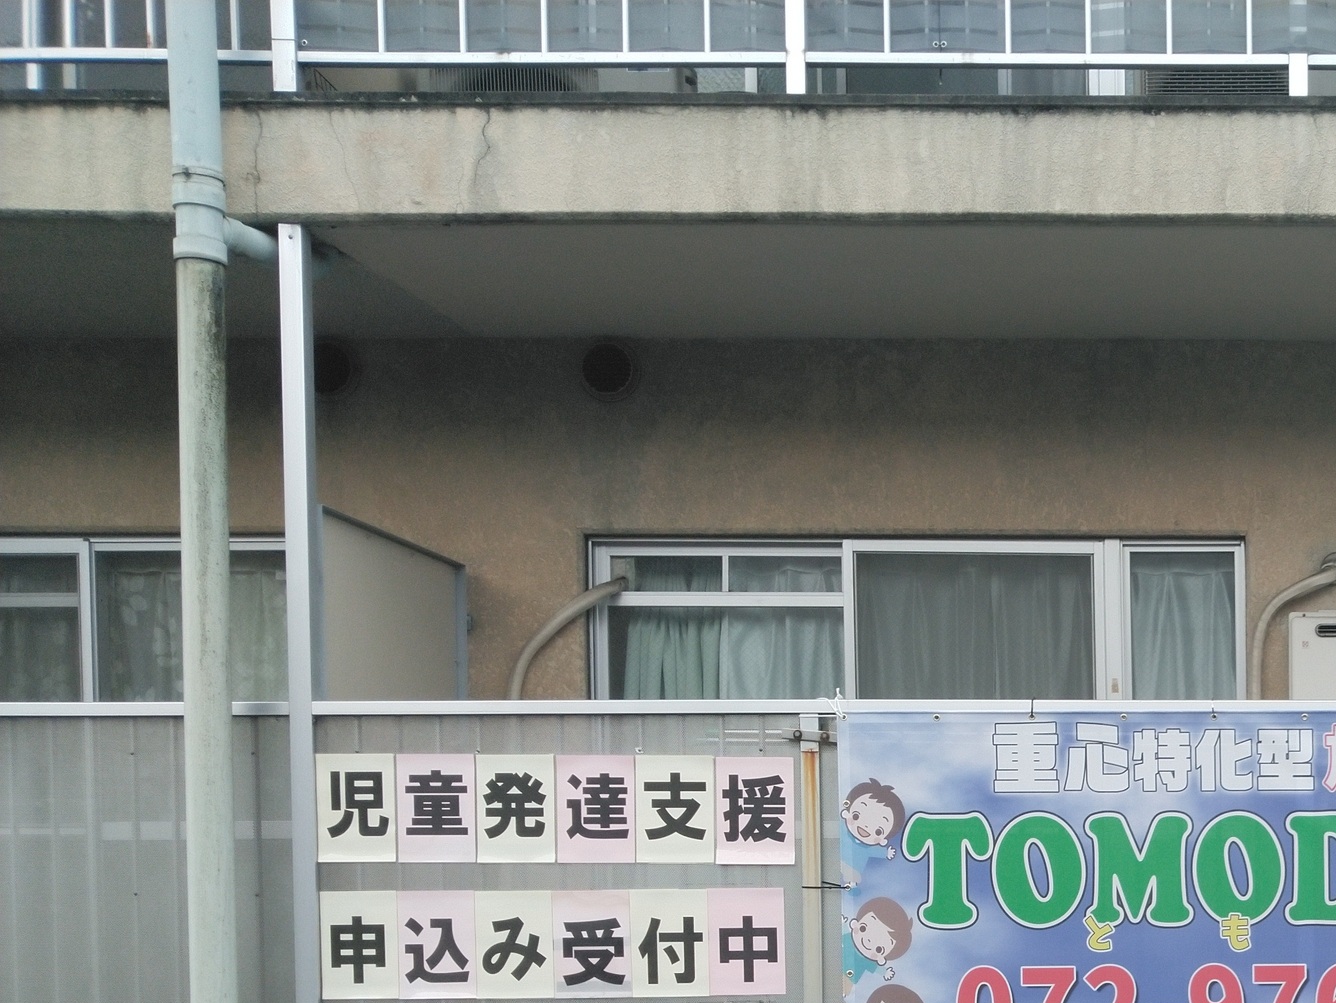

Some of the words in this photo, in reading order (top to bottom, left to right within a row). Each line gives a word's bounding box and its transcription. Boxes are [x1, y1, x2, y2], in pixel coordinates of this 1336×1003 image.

[992, 721, 1315, 793] 重心特化型
[327, 770, 787, 843] 児童発達支援
[330, 915, 778, 986] 申込み受付中
